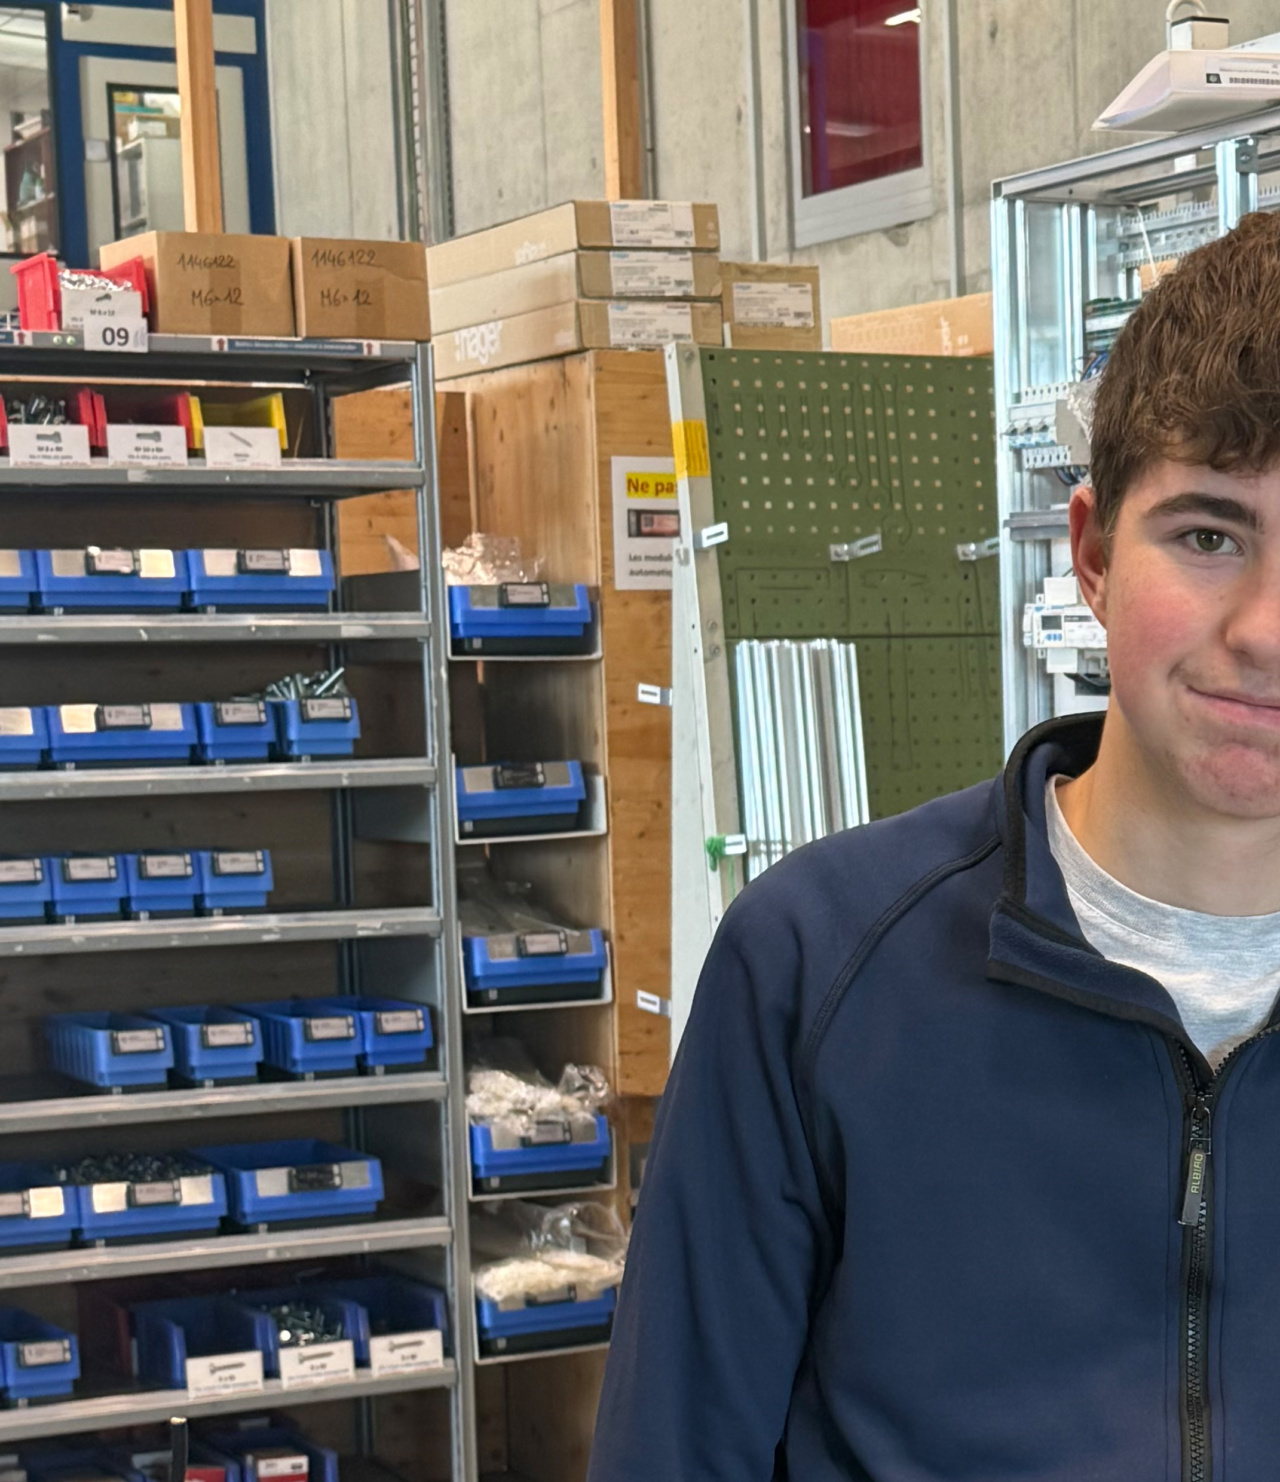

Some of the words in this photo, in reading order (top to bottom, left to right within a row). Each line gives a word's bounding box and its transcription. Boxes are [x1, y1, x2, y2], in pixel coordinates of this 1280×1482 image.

[177, 254, 237, 272] 1146122
[311, 249, 378, 268] 1146122
[102, 326, 130, 347] 09
[627, 478, 649, 493] Ne
[655, 483, 678, 497] pa
